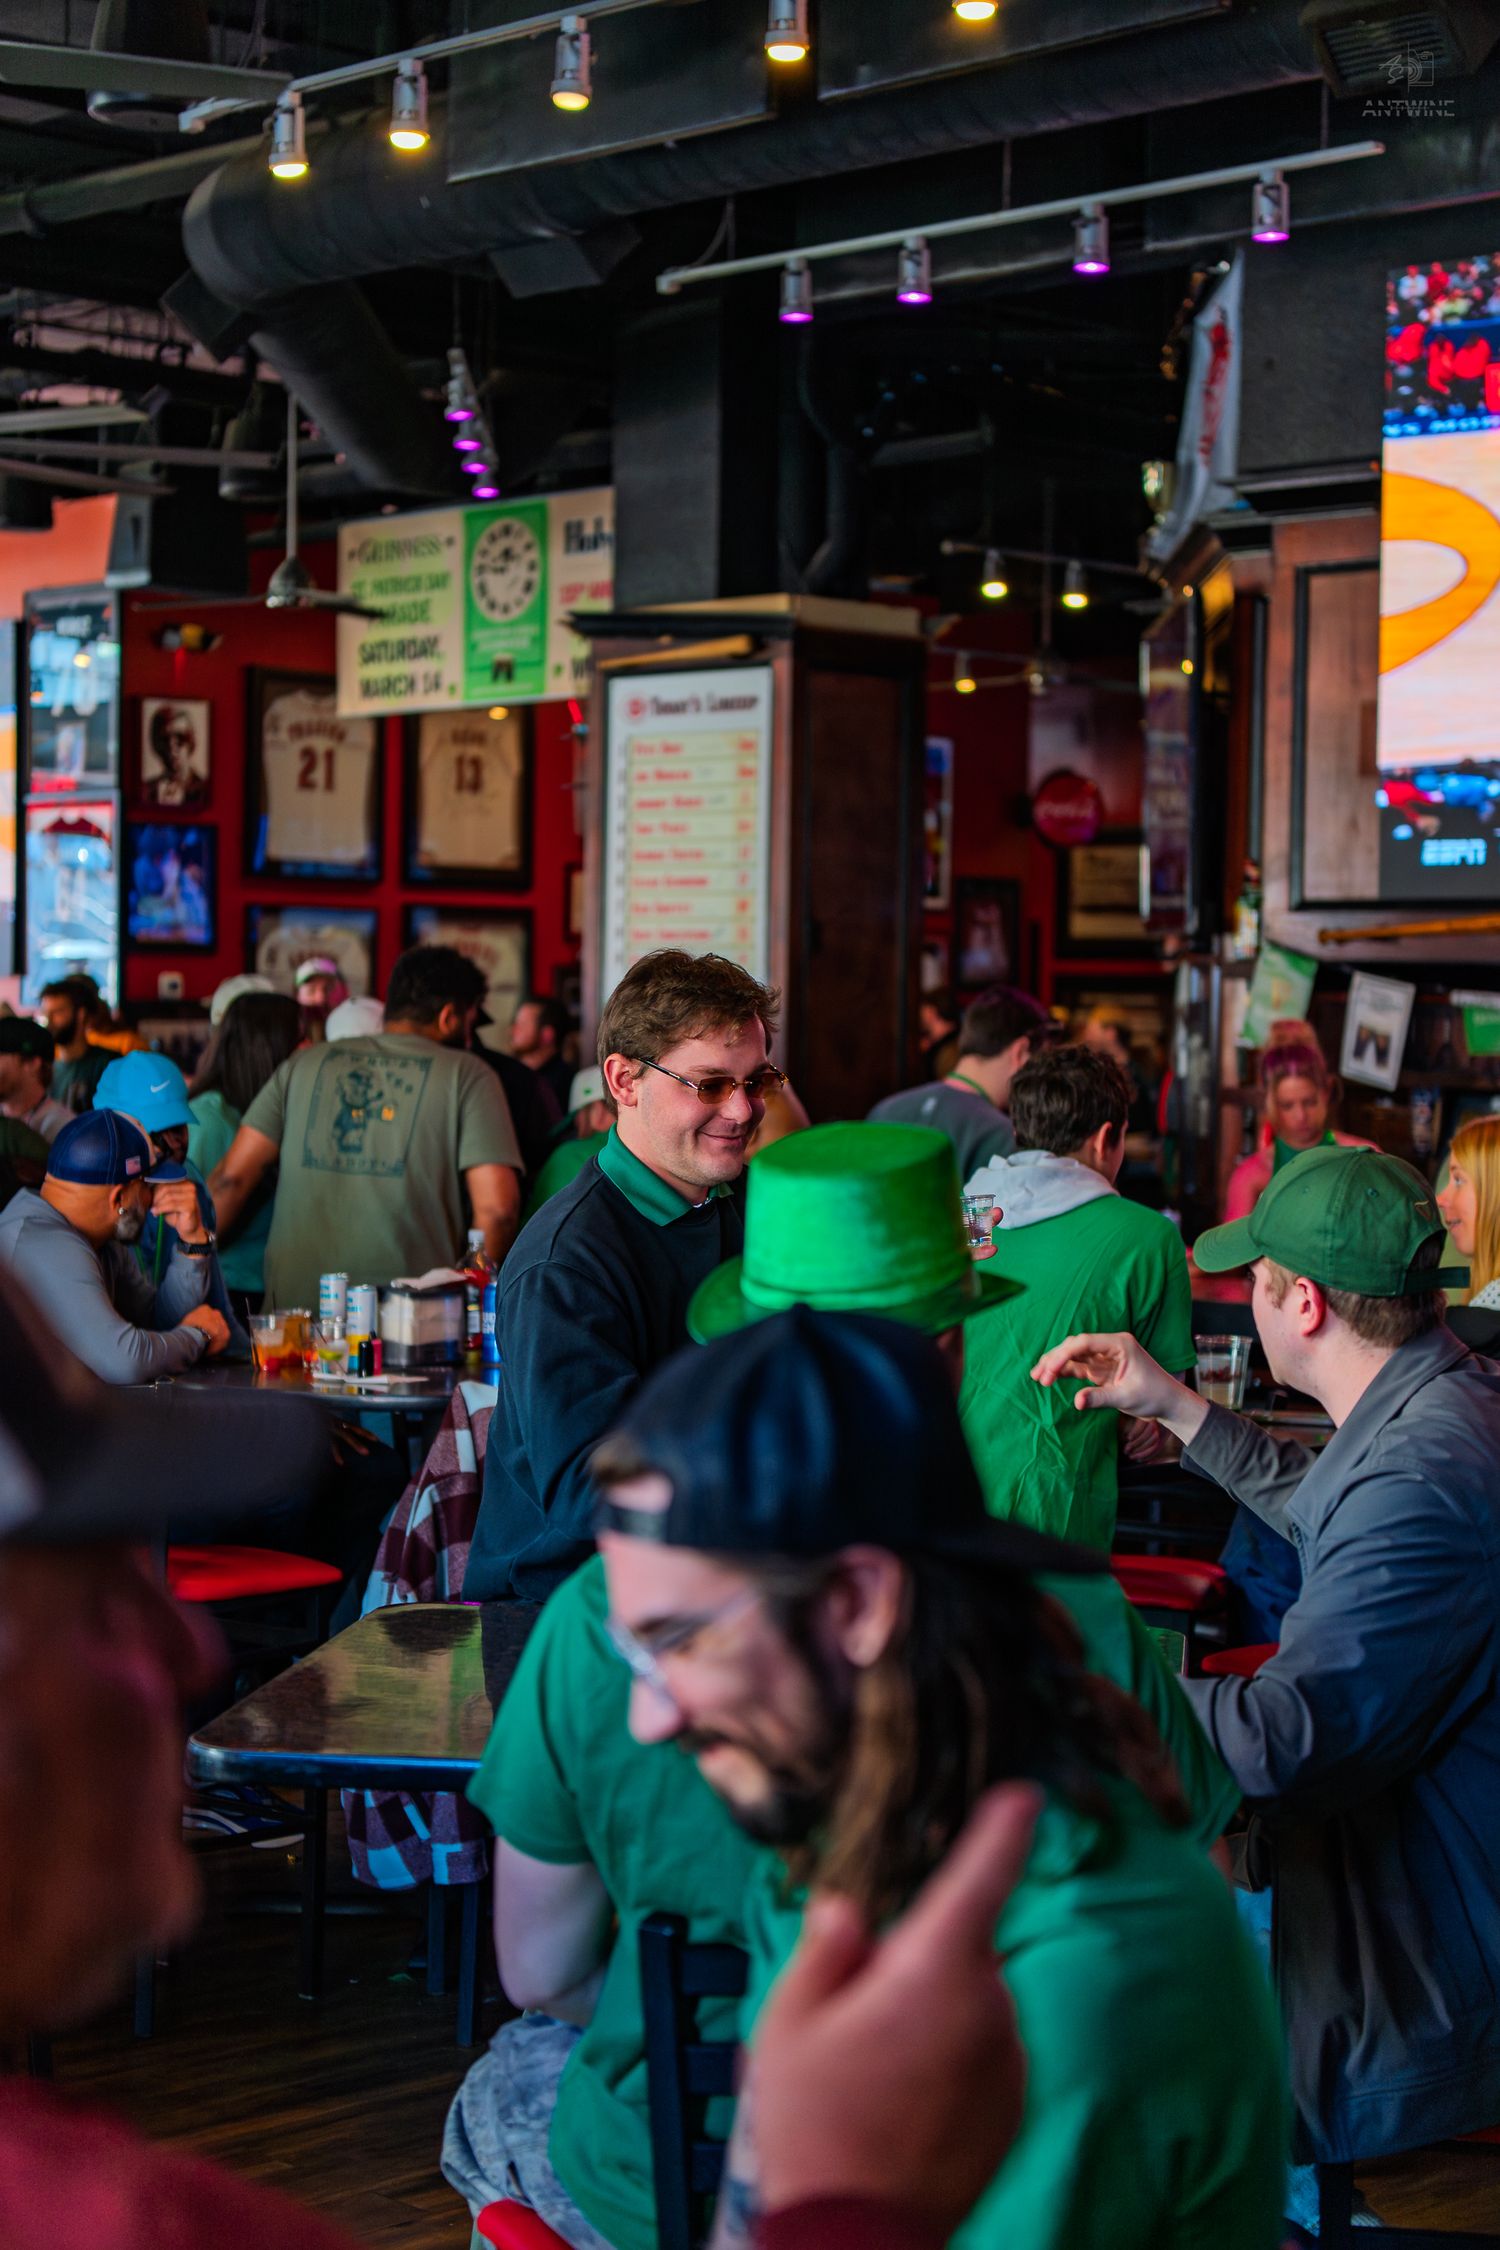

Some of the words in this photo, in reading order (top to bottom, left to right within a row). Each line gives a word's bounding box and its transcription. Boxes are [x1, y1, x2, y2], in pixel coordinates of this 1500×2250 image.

[361, 675, 414, 698] MARCH
[298, 747, 336, 792] 21
[455, 755, 482, 794] 13
[1421, 839, 1486, 866] ESPN
